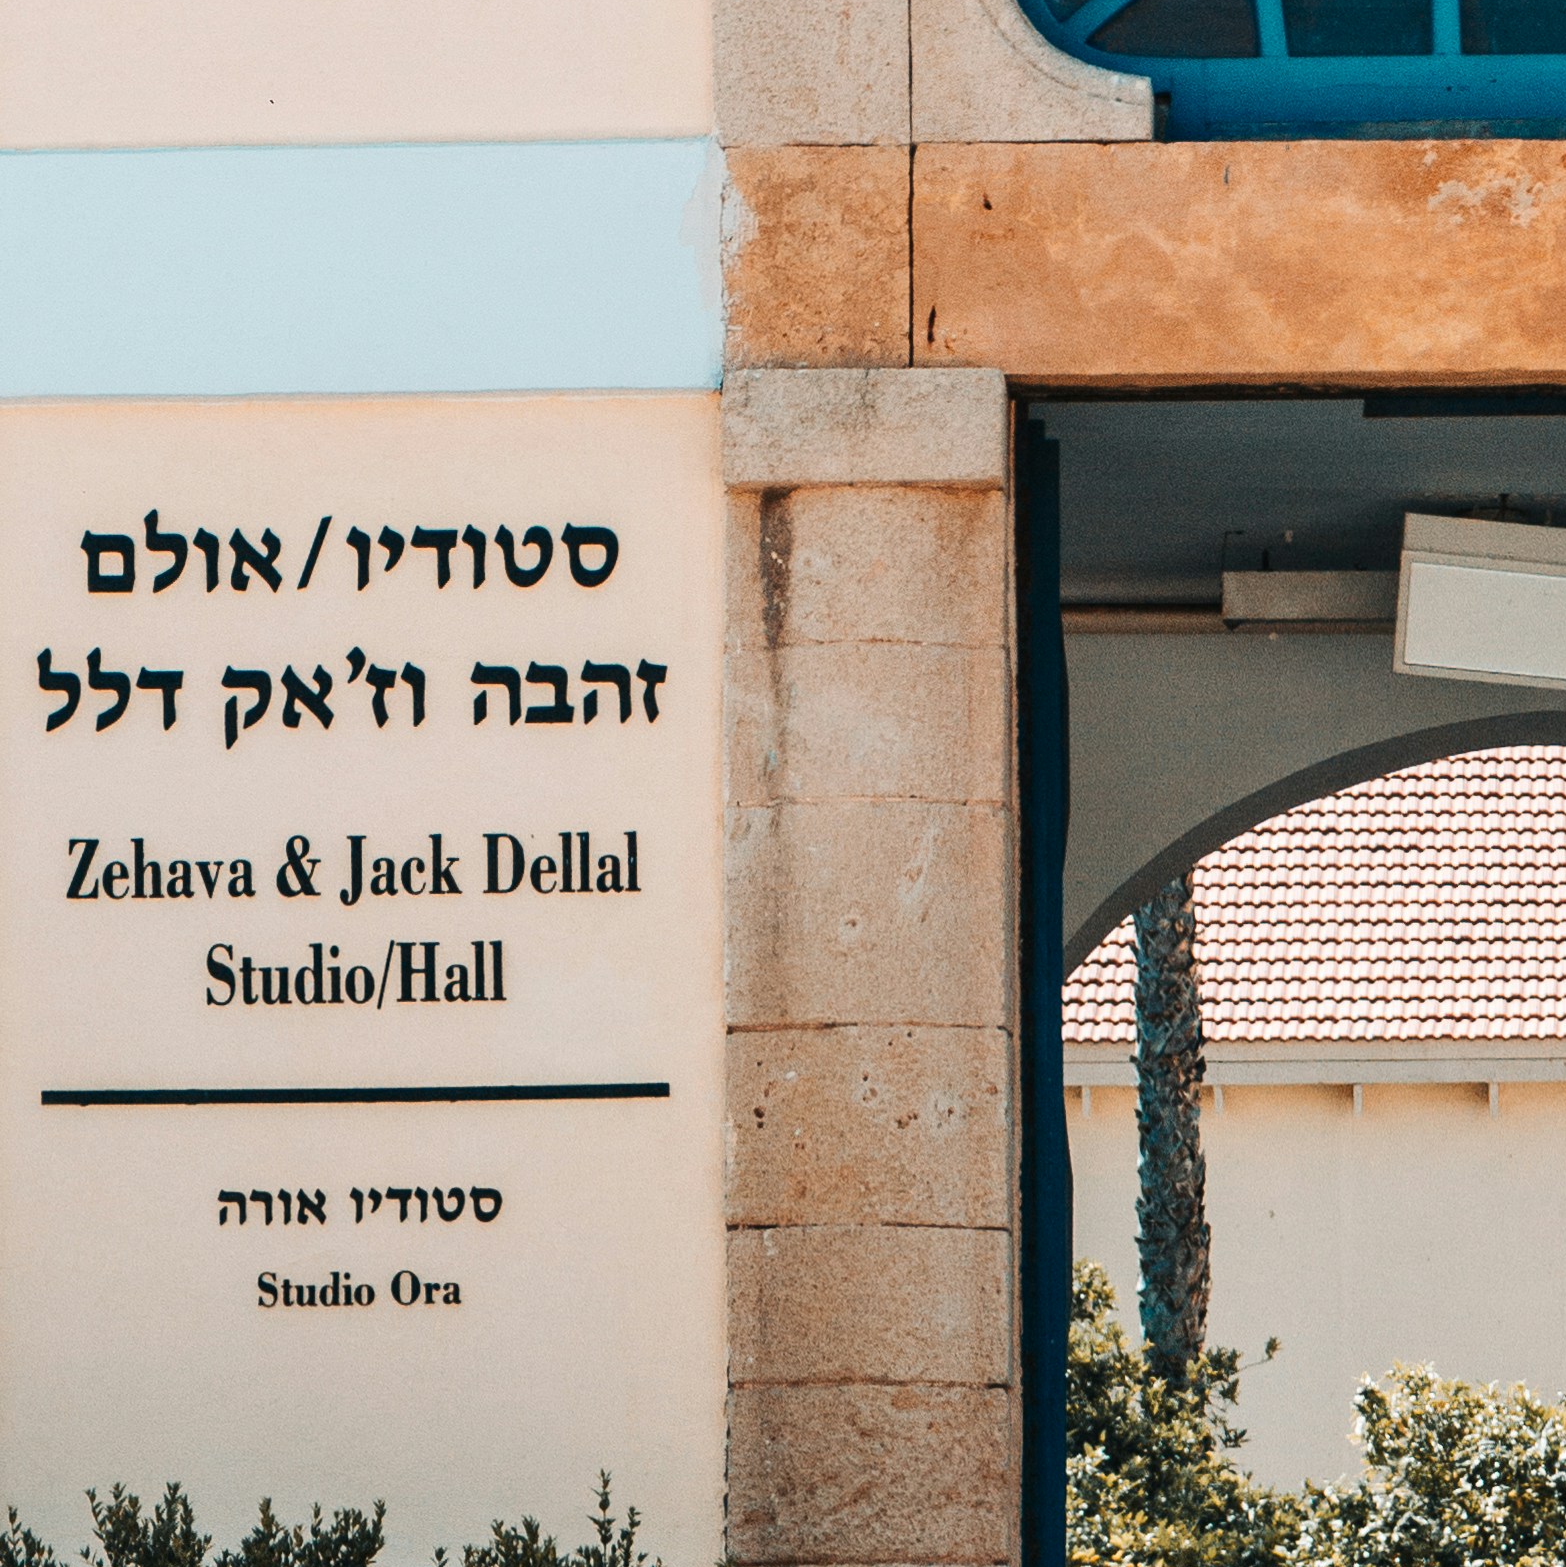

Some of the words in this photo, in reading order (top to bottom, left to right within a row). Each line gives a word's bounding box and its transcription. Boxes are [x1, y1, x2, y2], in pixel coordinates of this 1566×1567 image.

[36, 646, 185, 733] דלל
[470, 658, 668, 726] זהבה
[66, 837, 257, 900] Zehava
[276, 834, 322, 898] &
[339, 833, 463, 907] Jack
[482, 830, 642, 895] Dellal
[217, 1188, 327, 1226] אורה
[349, 1185, 503, 1225] סטודיו
[257, 1271, 376, 1309] Studio
[390, 1269, 462, 1307] Ora
